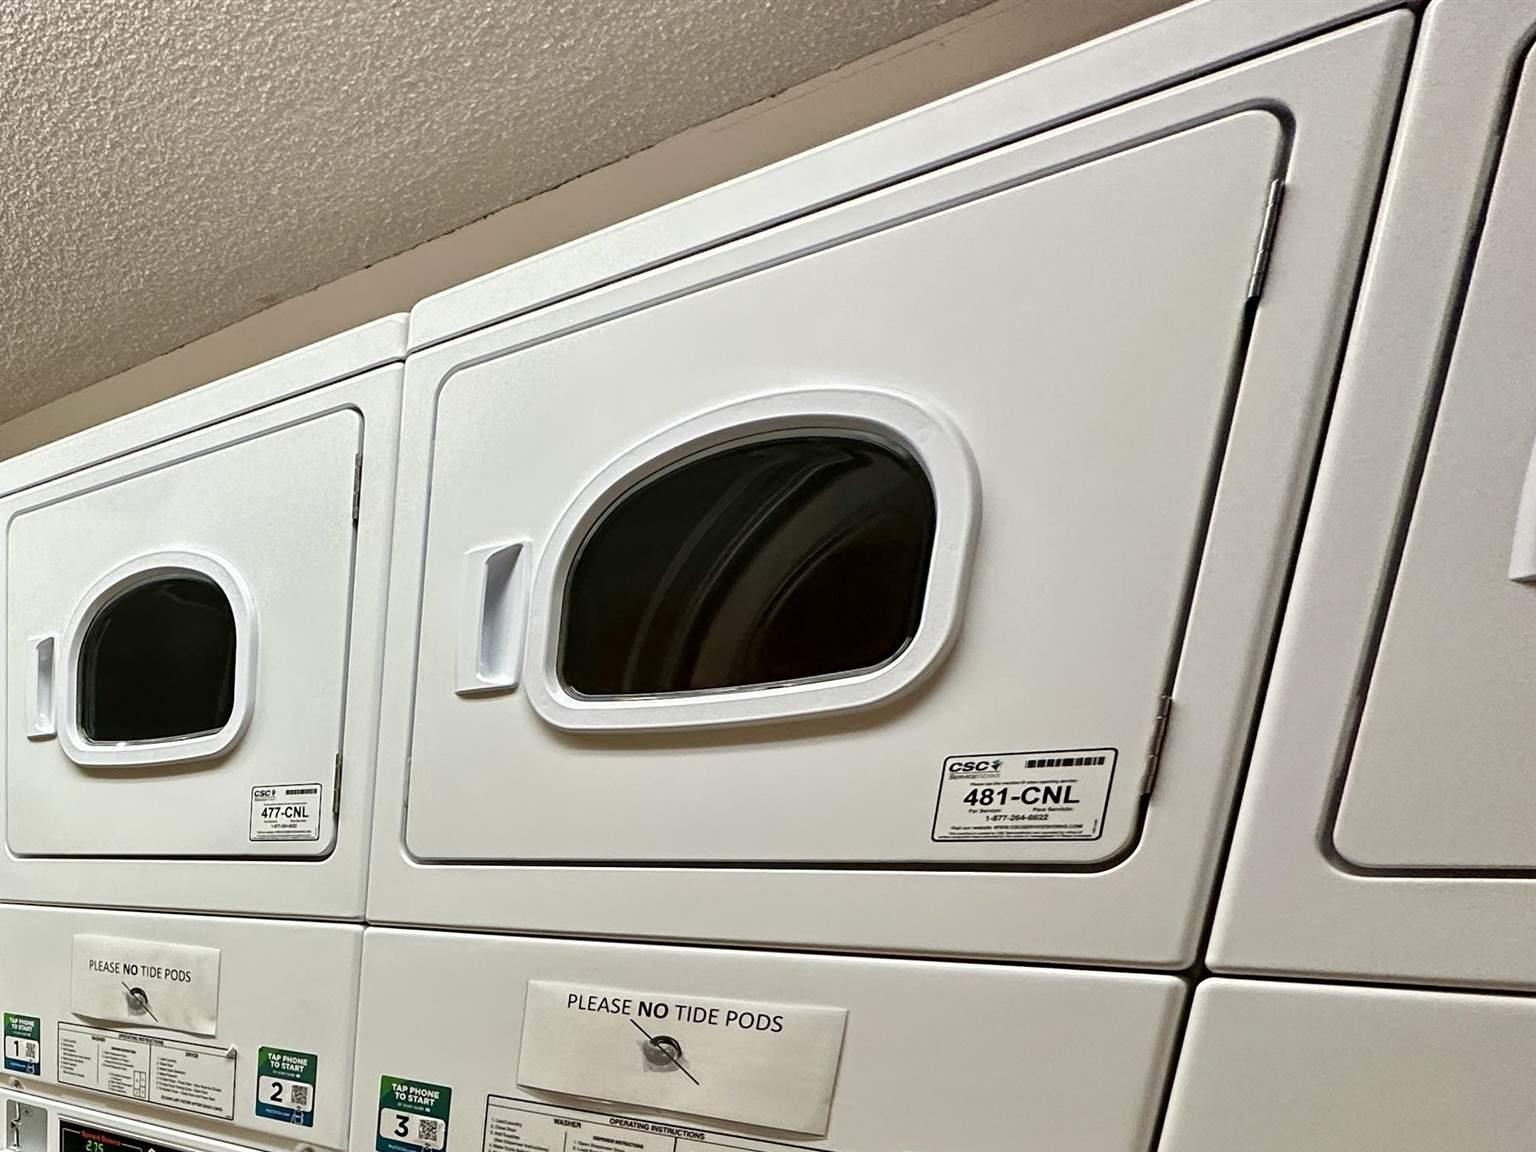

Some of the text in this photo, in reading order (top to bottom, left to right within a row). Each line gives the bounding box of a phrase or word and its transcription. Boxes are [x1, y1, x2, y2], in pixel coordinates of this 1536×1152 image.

[949, 761, 990, 772] CSC
[963, 785, 1080, 806] 481-CNL
[261, 806, 309, 818] 477-CNL
[89, 959, 192, 983] PLEASE NO TIDE PODS
[567, 993, 784, 1033] PLEASE NO TIDE PODS
[14, 1040, 19, 1057] 1
[268, 1053, 308, 1066] TAP PHONE
[270, 1061, 304, 1073] TO START
[270, 1081, 283, 1103] 2
[392, 1083, 440, 1099] TAP PHONE
[395, 1092, 435, 1106] TO START
[394, 1114, 410, 1138] 3
[553, 1118, 582, 1129] WASHER
[609, 1118, 706, 1141] OPERATING INSTRUCTIONS
